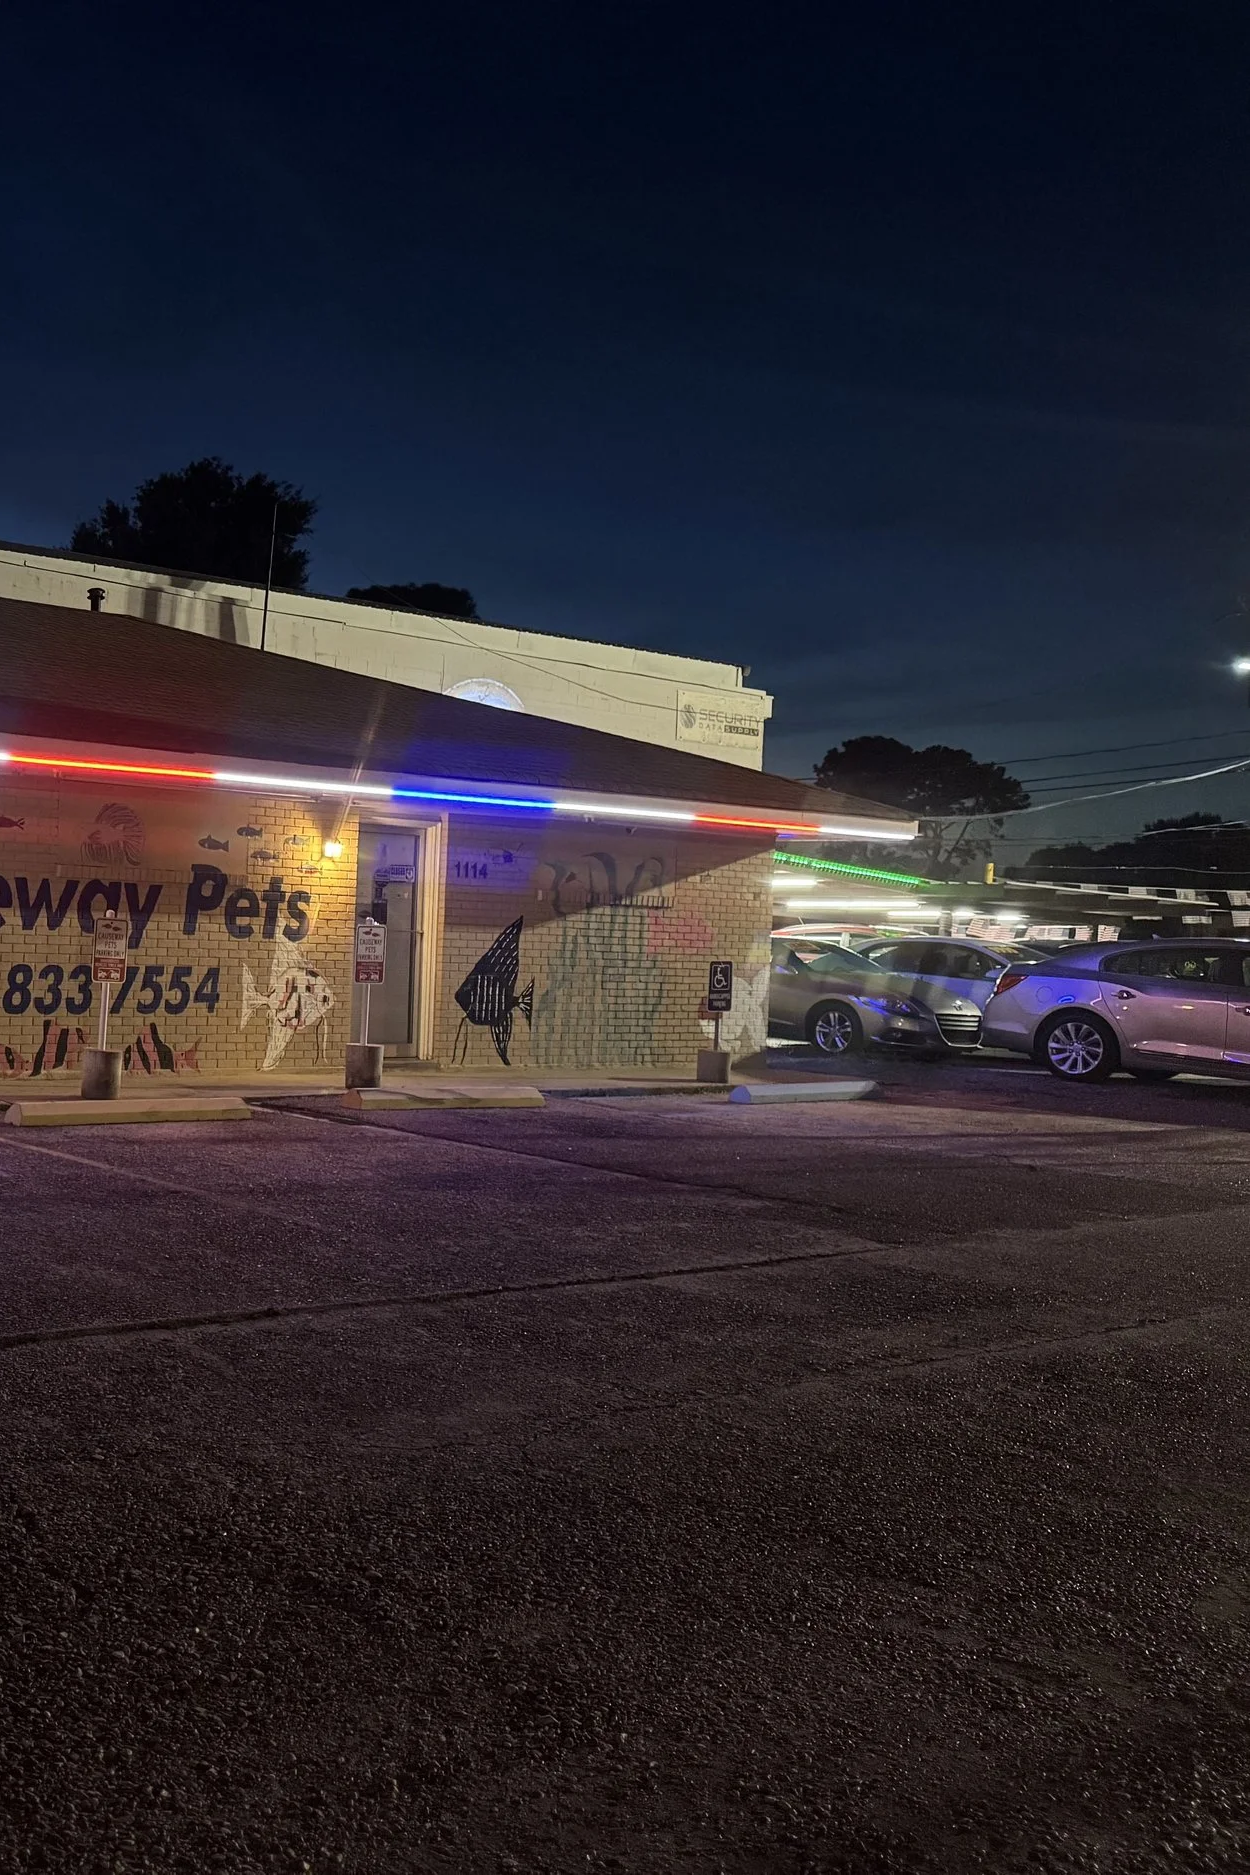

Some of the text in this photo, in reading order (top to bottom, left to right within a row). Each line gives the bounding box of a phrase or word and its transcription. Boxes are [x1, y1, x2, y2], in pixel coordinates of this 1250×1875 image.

[698, 709, 760, 729] SECURITY
[699, 722, 759, 737] DATA SUPPLY
[455, 861, 488, 879] 1114
[182, 864, 312, 942] Pets
[97, 933, 124, 941] CAUSEWAY
[104, 941, 117, 949] PETS
[2, 963, 93, 1016] 833
[109, 965, 220, 1015] 7554
